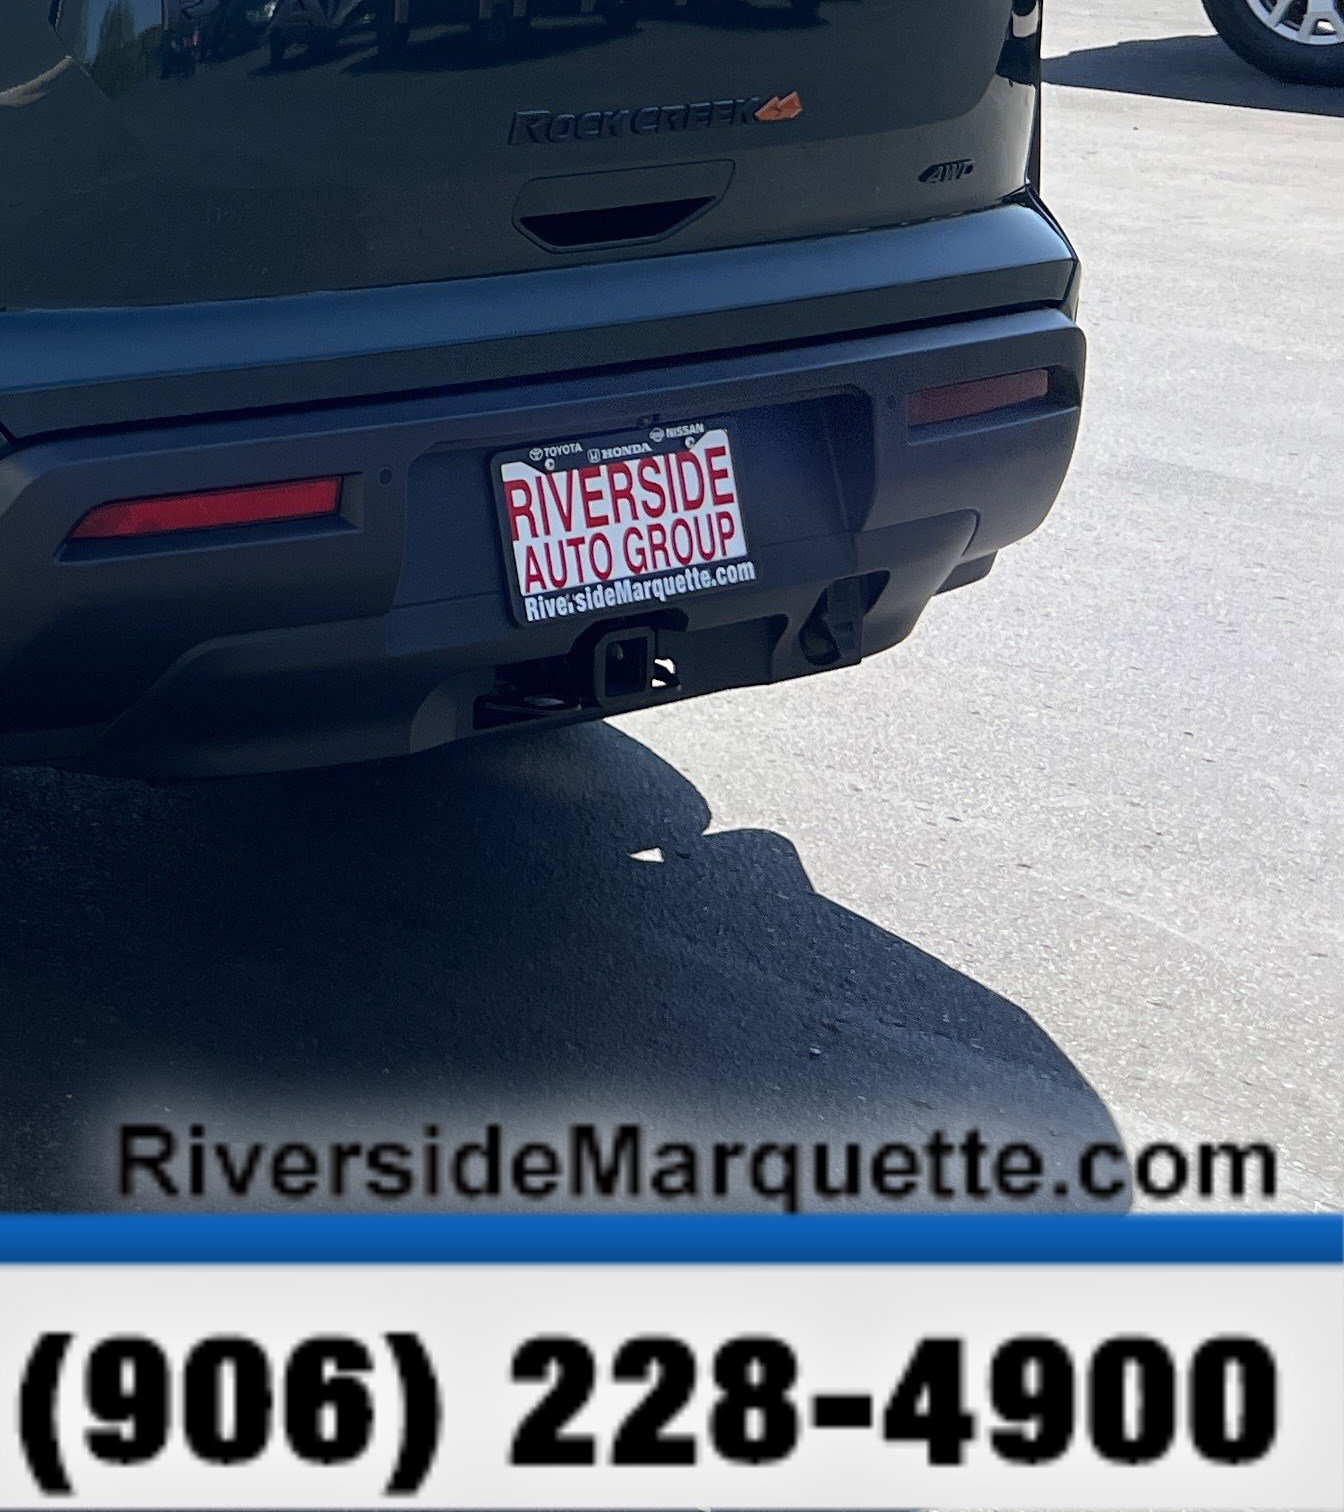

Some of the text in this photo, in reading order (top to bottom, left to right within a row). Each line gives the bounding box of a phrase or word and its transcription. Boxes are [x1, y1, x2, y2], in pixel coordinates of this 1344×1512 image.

[508, 96, 759, 145] ROCK CREEK
[544, 442, 584, 458] TOYOTA
[601, 442, 653, 459] HONDA
[665, 423, 705, 439] NISSAN
[503, 445, 735, 541] RIVERSIDE
[524, 510, 736, 594] AUTO GROUP
[524, 560, 756, 622] RiversideMarquette.com
